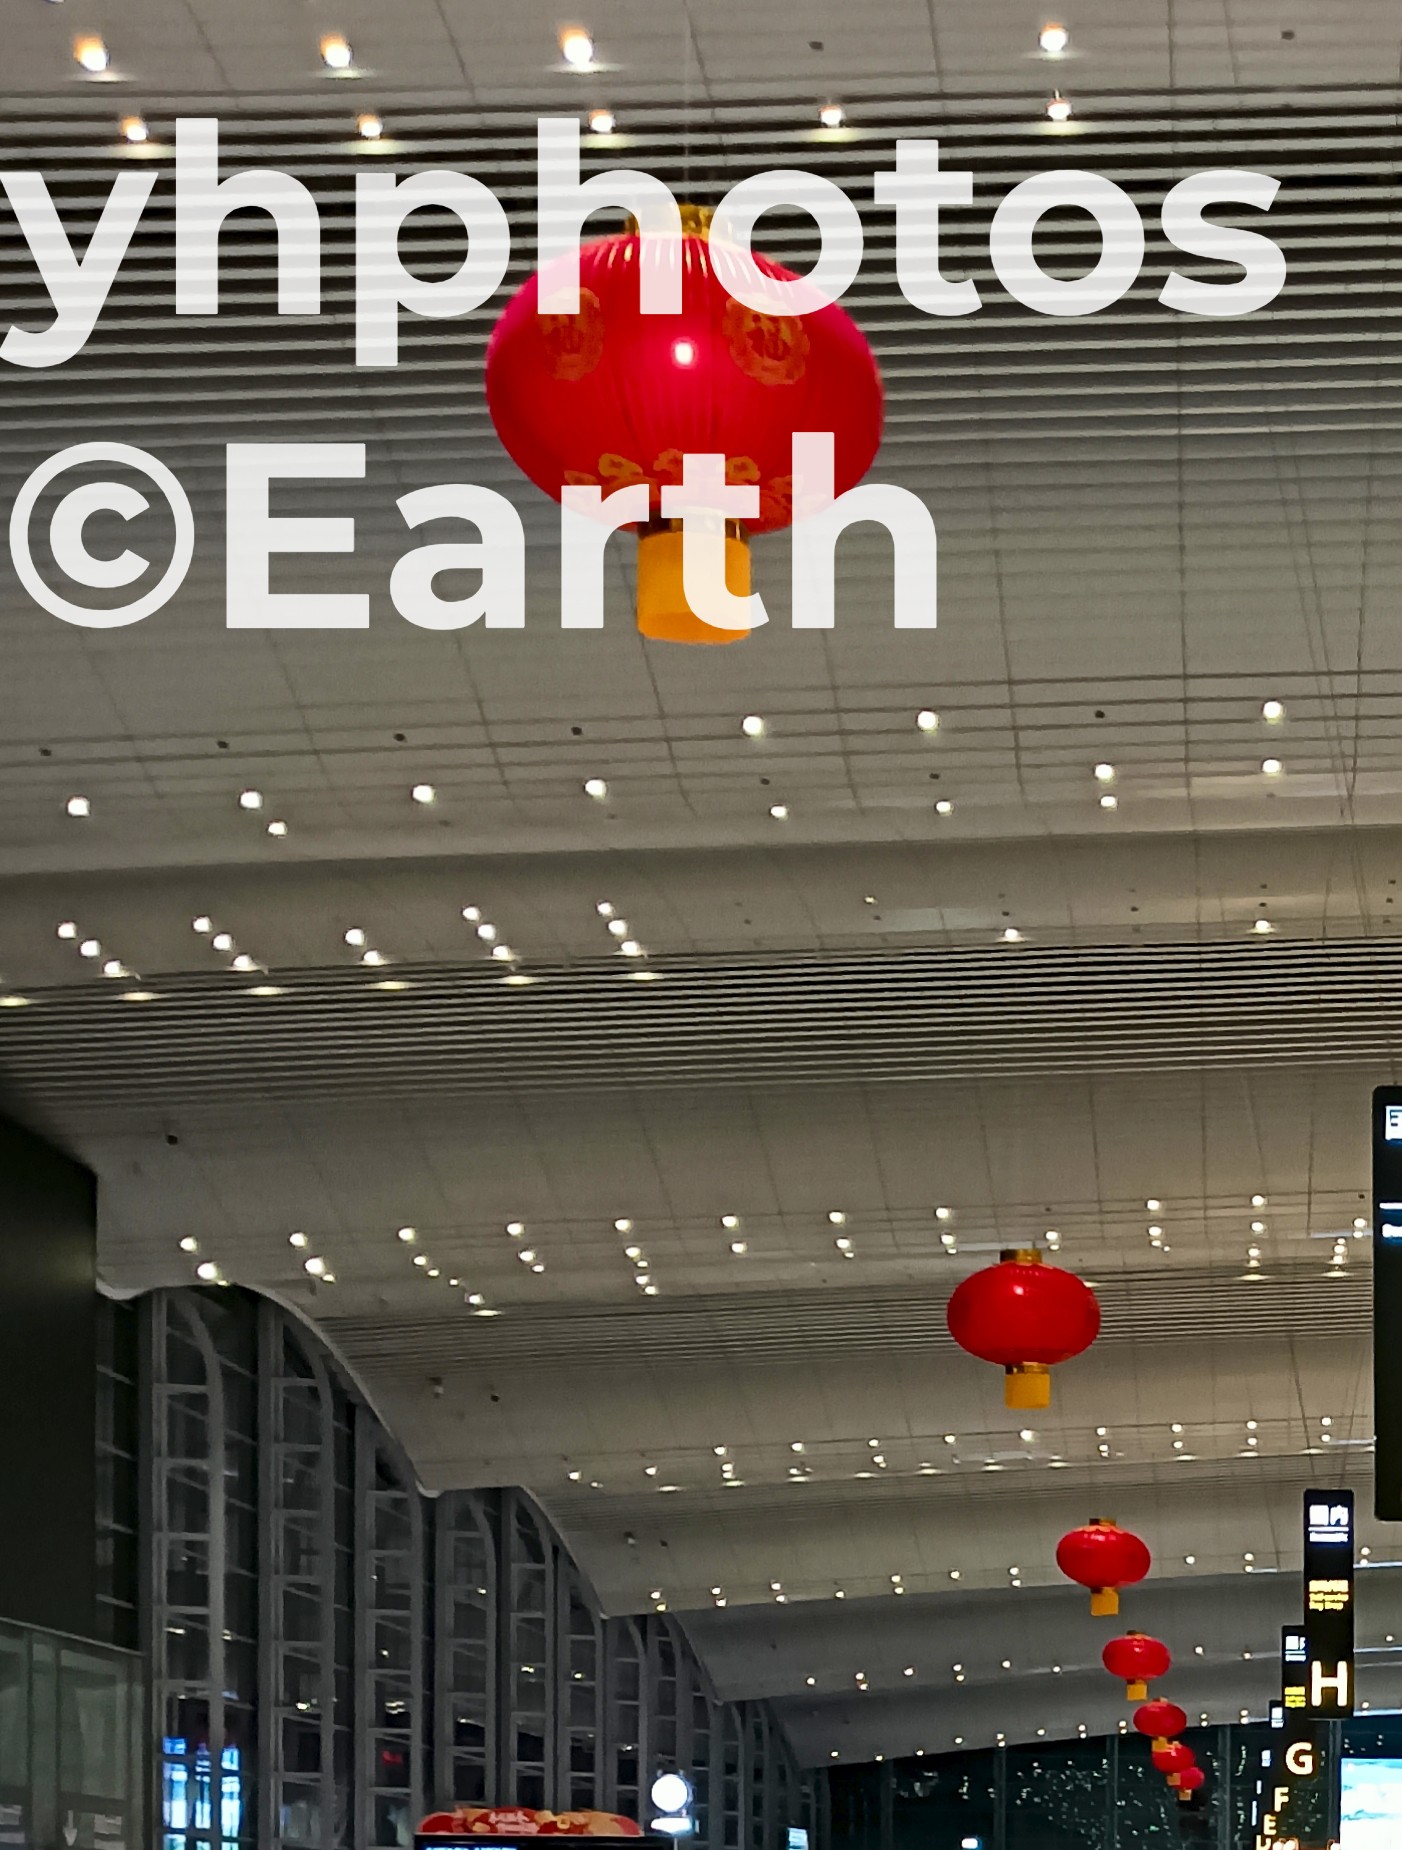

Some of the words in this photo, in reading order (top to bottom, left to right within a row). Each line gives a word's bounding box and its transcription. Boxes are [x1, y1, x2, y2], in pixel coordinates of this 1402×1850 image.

[1311, 1660, 1348, 1707] H
[1285, 1741, 1313, 1775] G
[1274, 1786, 1290, 1813] F
[1263, 1814, 1277, 1836] E
